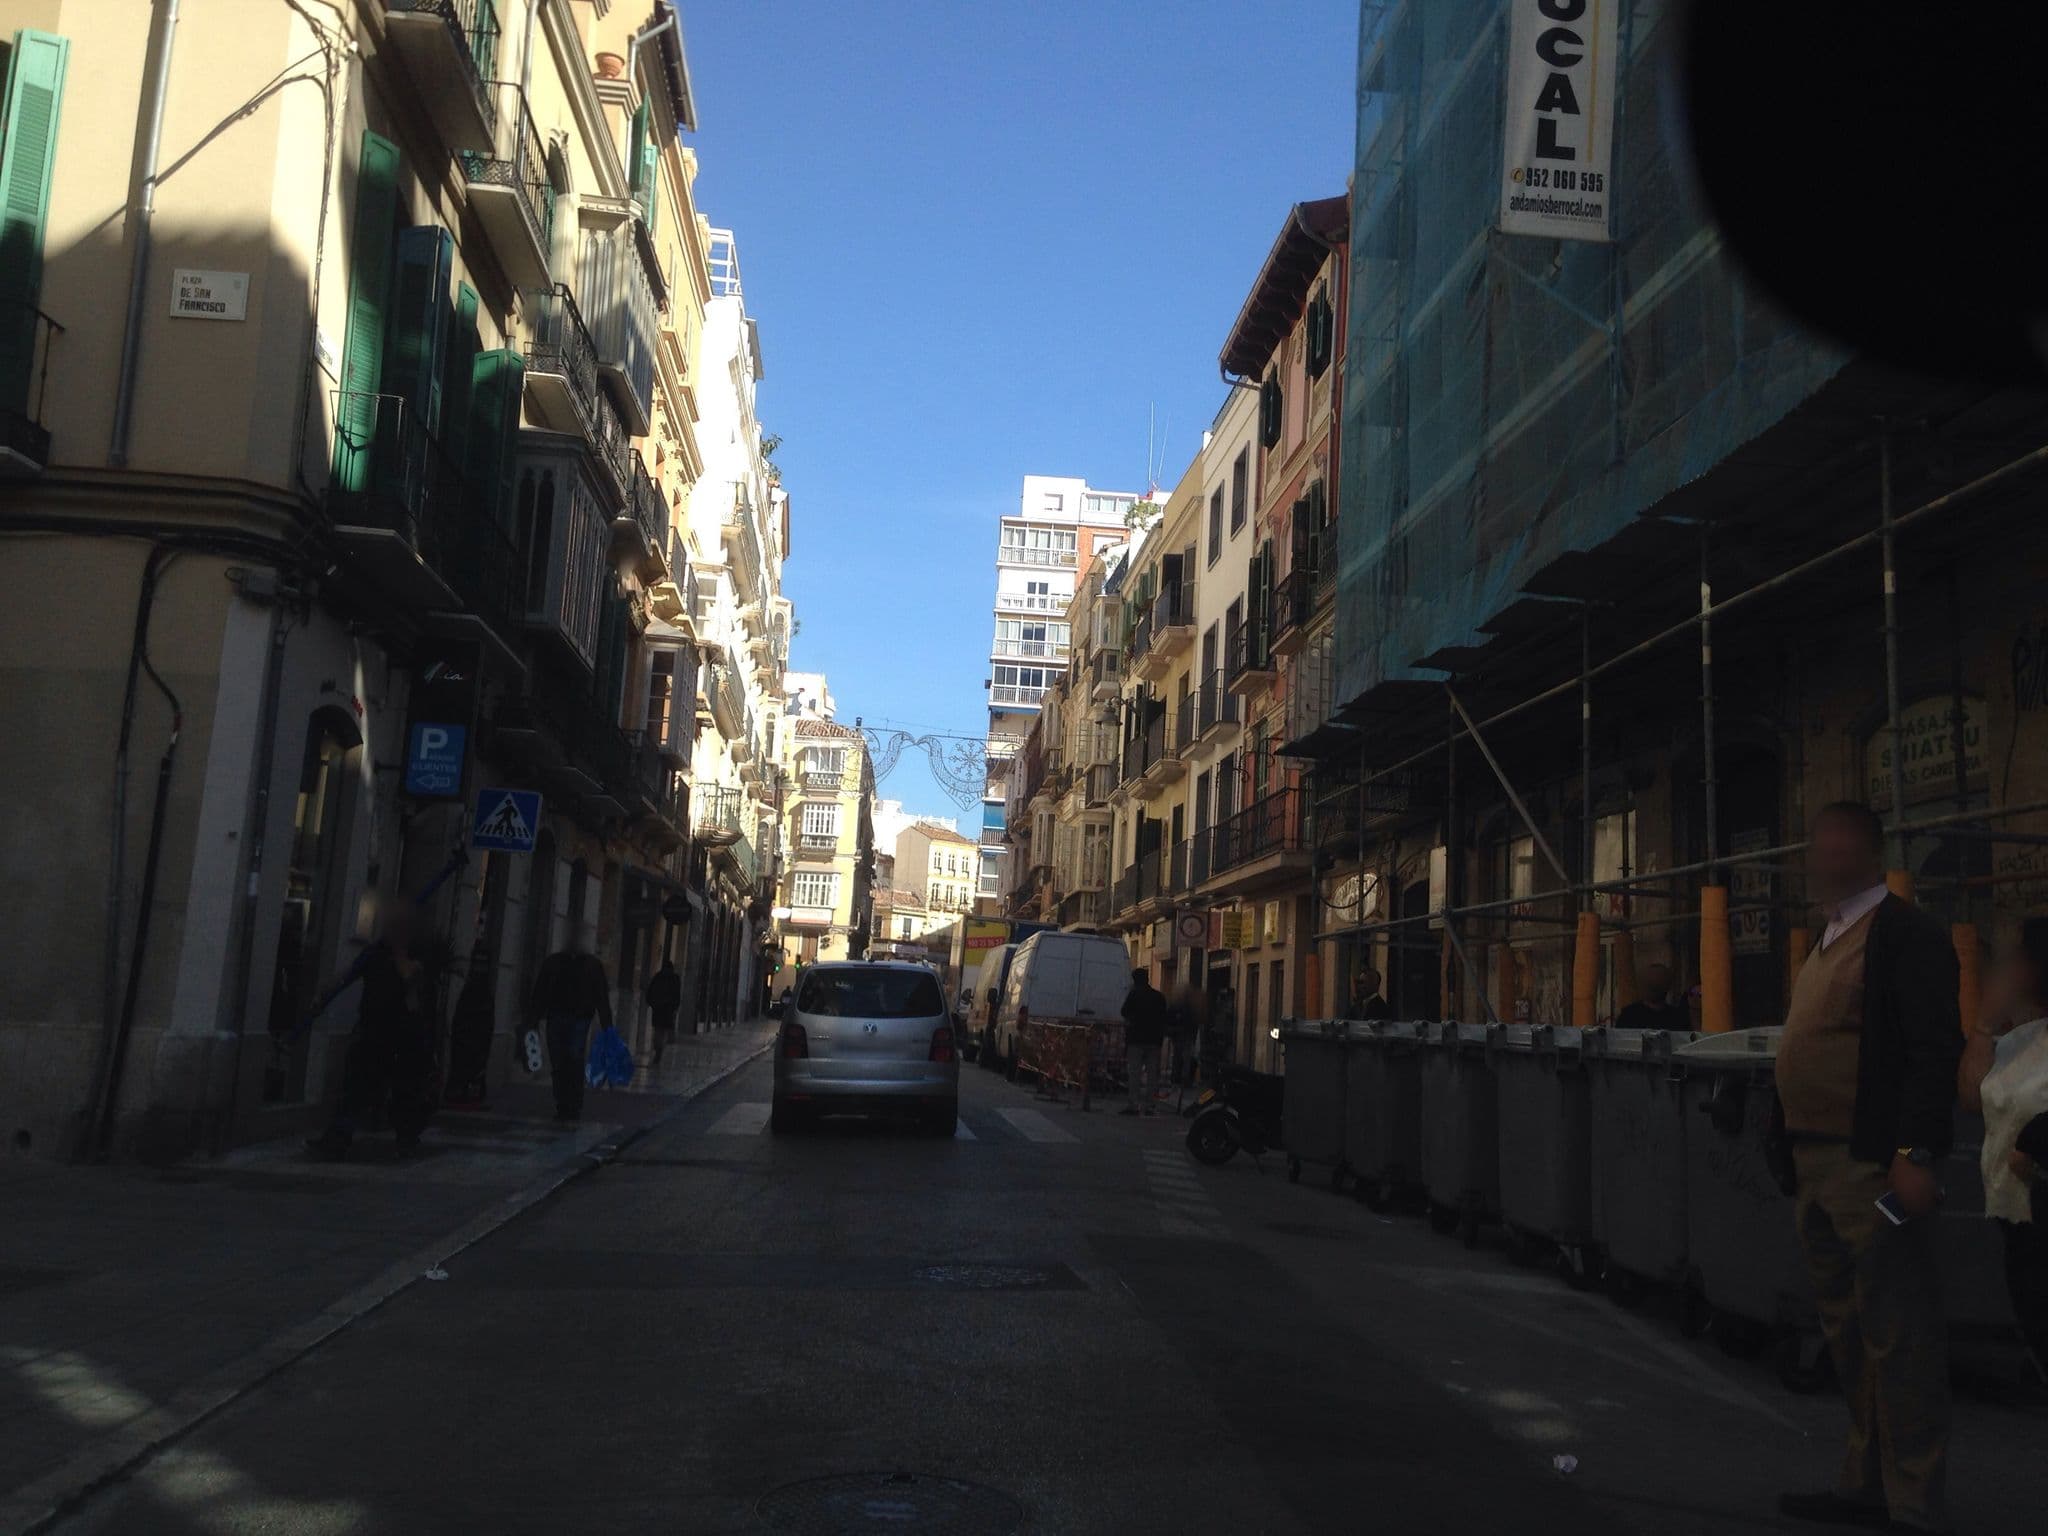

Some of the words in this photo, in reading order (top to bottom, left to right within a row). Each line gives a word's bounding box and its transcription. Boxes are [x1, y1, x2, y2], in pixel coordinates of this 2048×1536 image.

[1525, 168, 1549, 188] 952
[1580, 172, 1603, 192] 595
[1510, 192, 1602, 219] andamiosberrocal.com
[181, 287, 192, 298] DE
[194, 287, 211, 299] SAN
[179, 299, 226, 313] FRANCISCO
[420, 727, 449, 761] P
